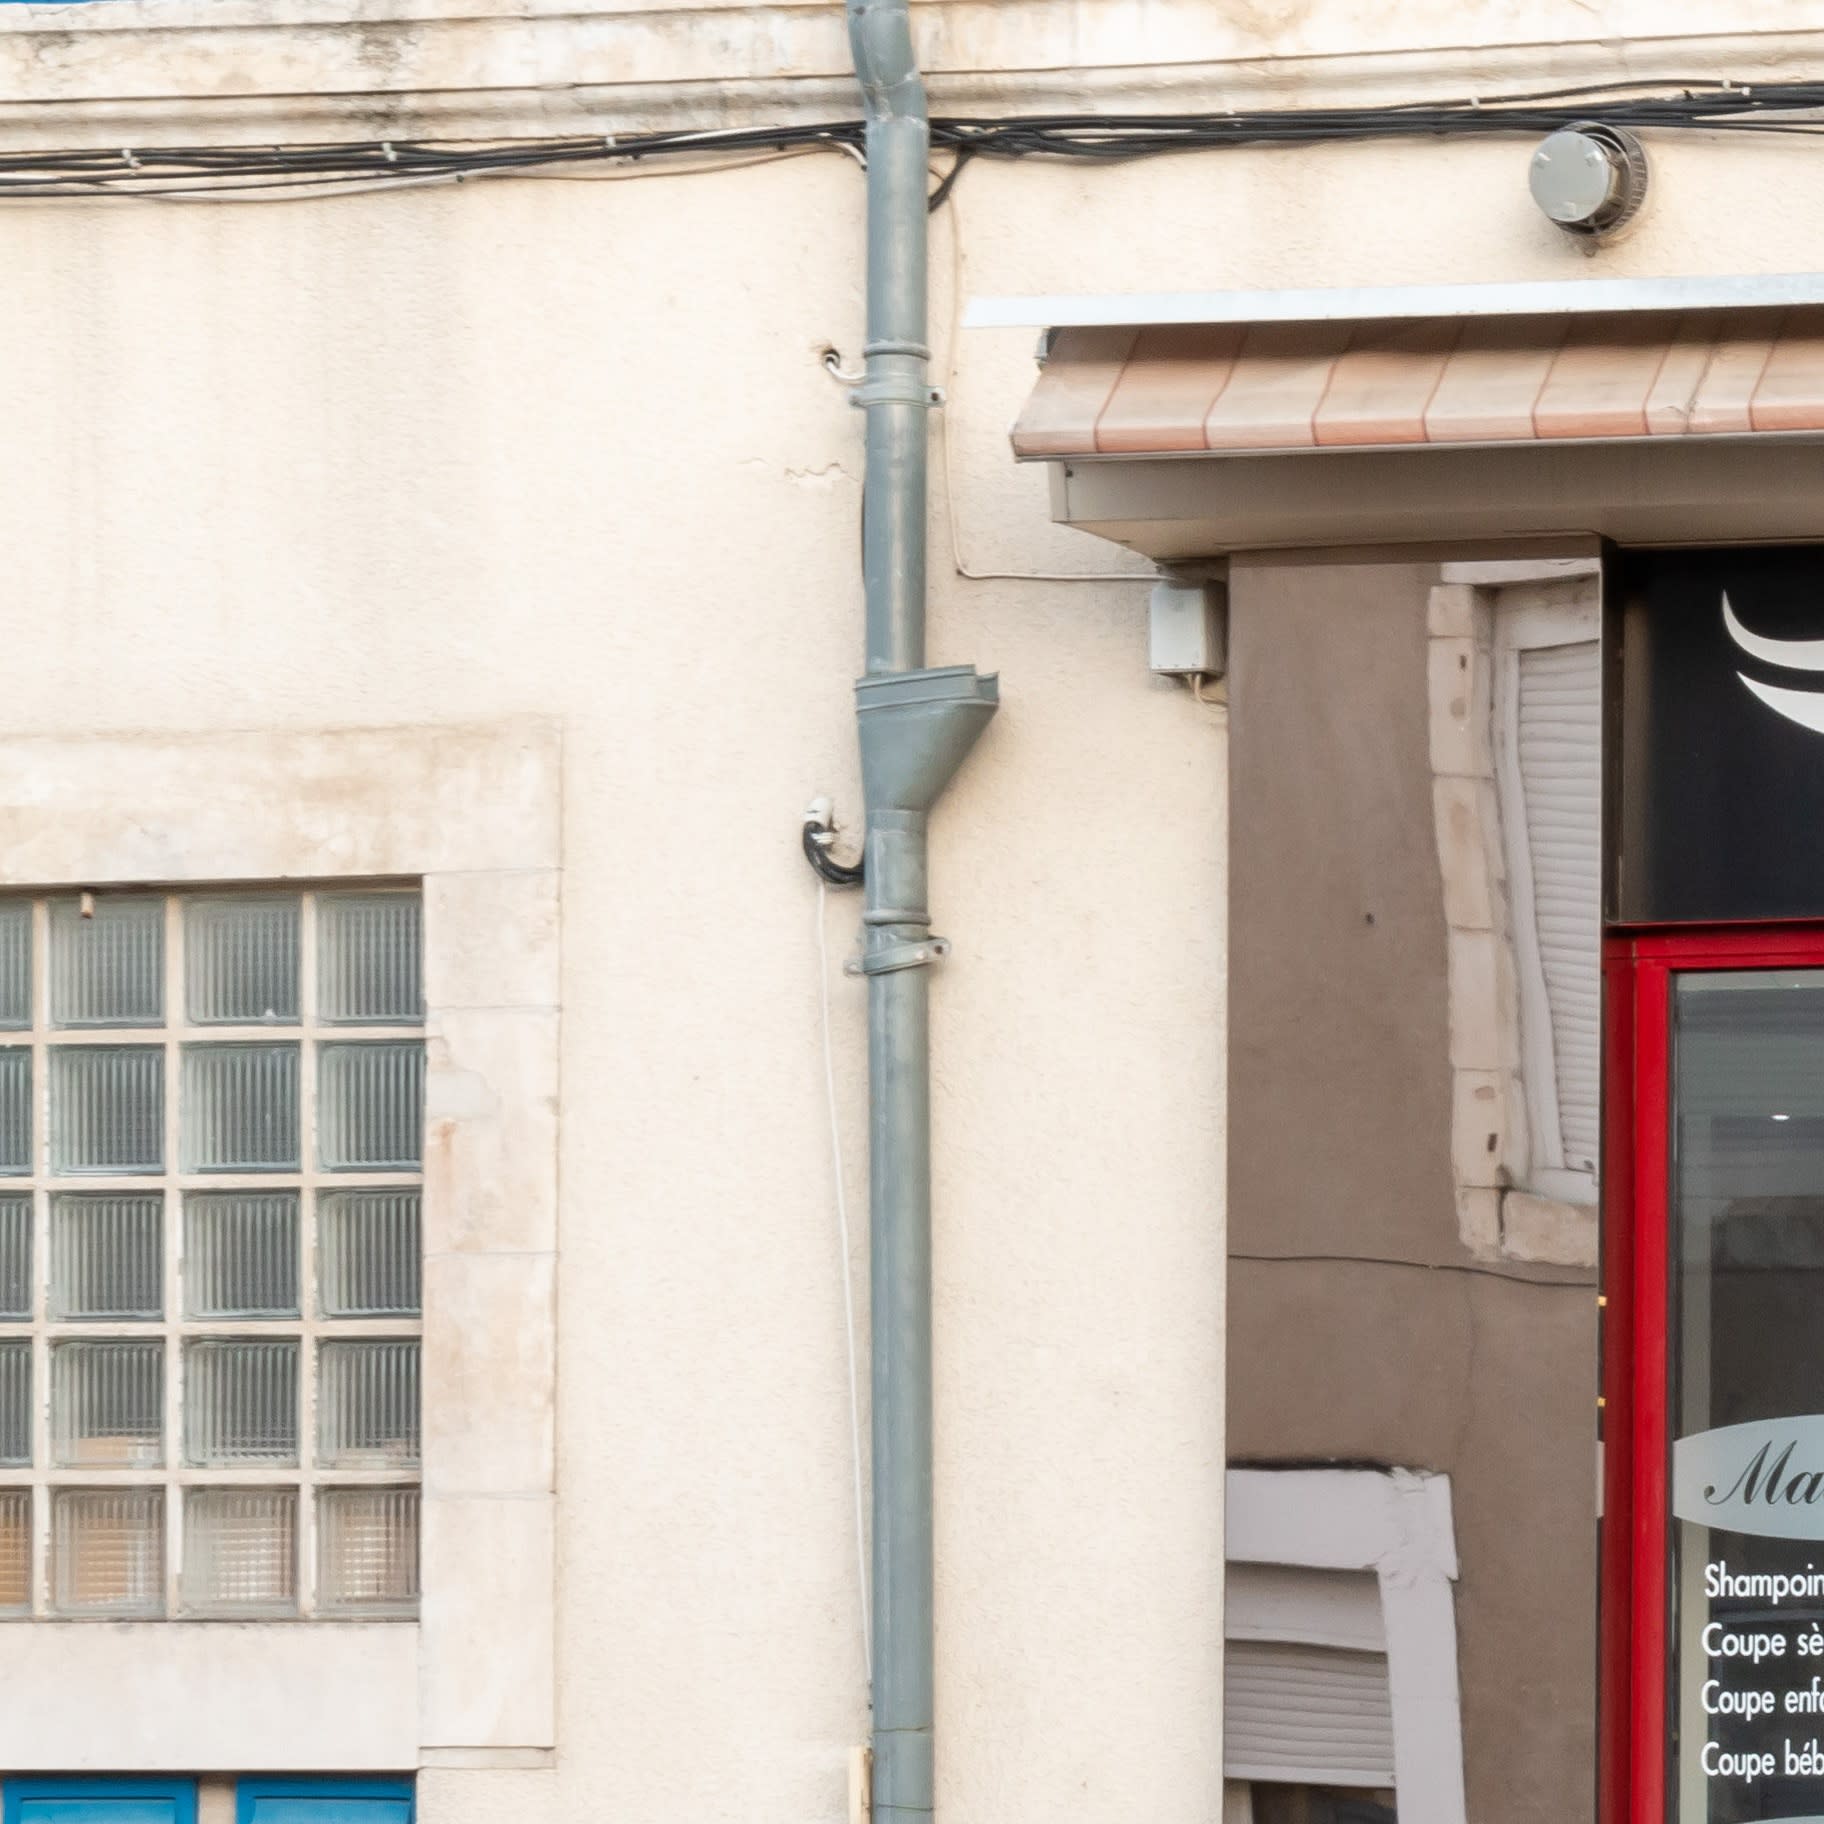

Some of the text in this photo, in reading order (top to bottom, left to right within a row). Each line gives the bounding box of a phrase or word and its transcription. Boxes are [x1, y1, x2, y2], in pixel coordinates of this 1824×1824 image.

[1701, 1623, 1786, 1664] Coupe
[1701, 1679, 1775, 1721] Coupe
[1701, 1741, 1776, 1781] Coupe
